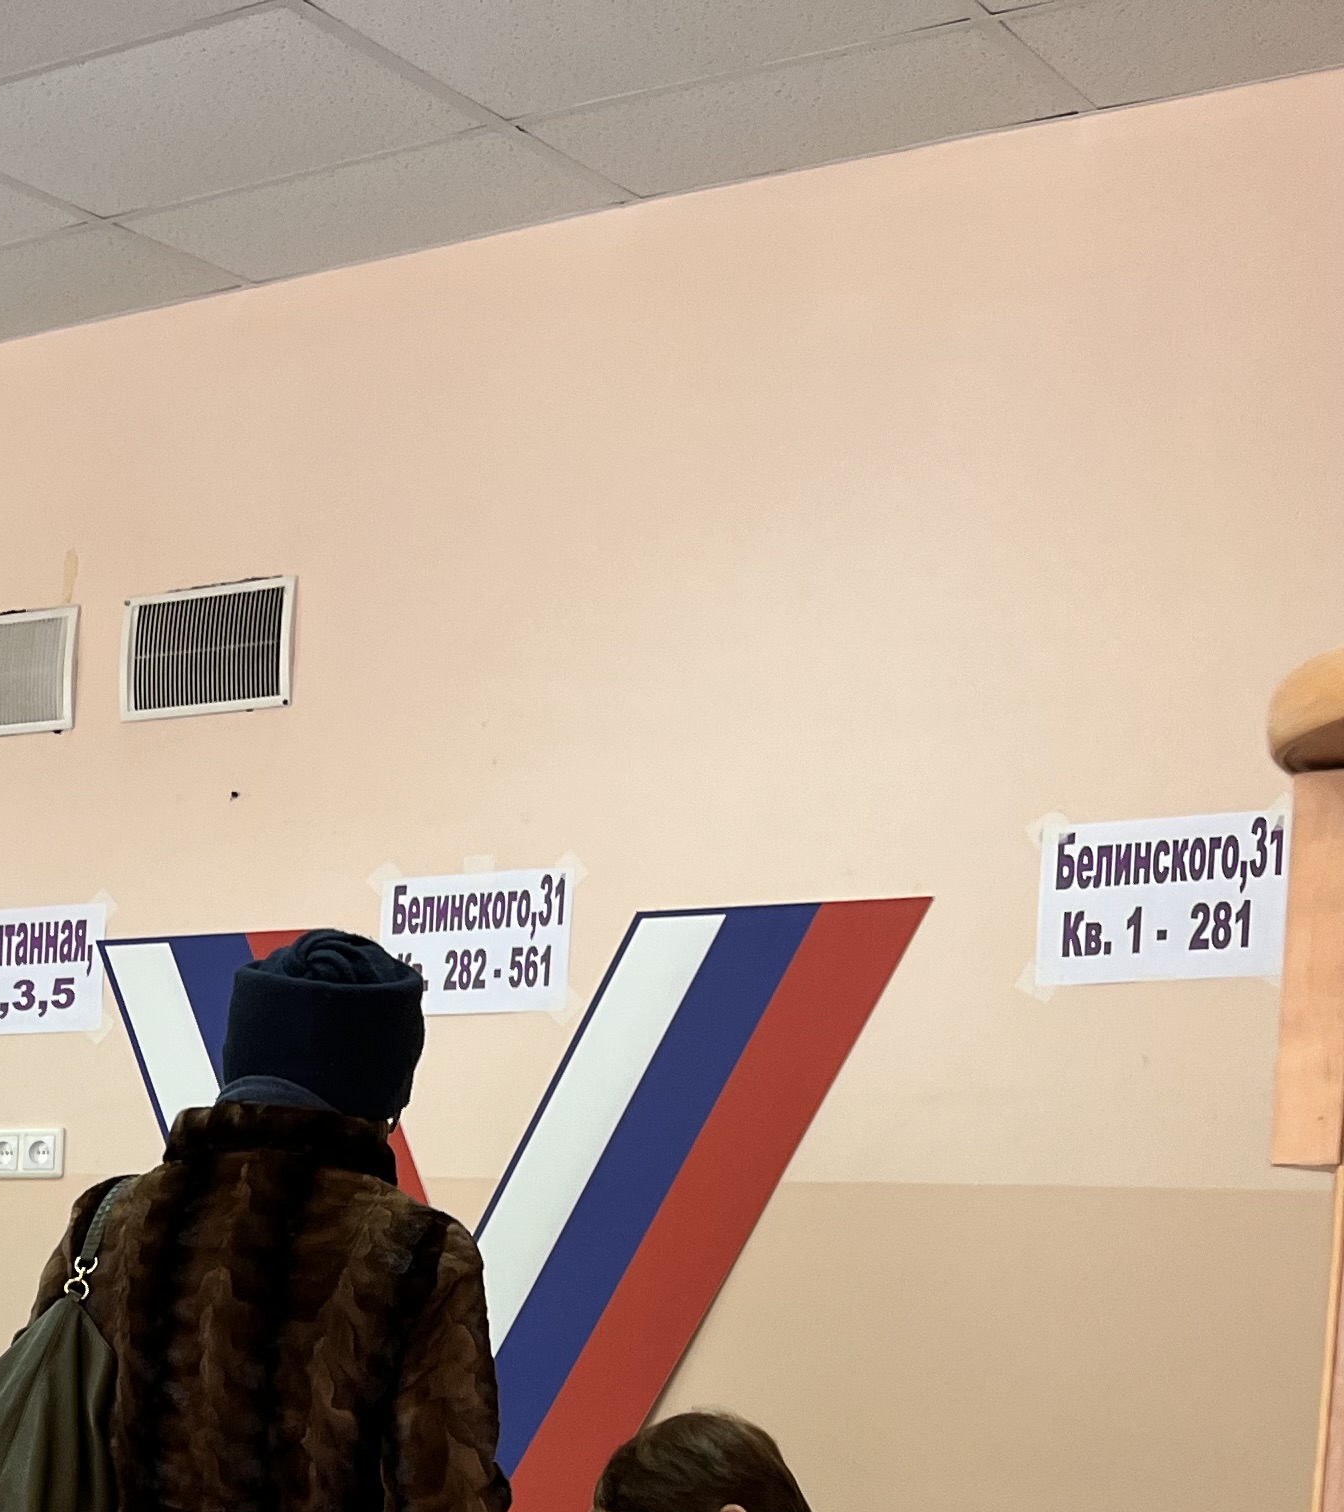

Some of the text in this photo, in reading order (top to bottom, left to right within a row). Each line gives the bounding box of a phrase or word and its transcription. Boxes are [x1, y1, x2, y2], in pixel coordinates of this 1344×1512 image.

[1055, 815, 1285, 894] Белинского,31
[391, 873, 567, 940] Белинского,31
[1062, 910, 1112, 958] Кв.
[1126, 906, 1143, 954] 1
[1188, 899, 1252, 951] 281
[443, 948, 487, 991] 282
[508, 944, 552, 988] 561
